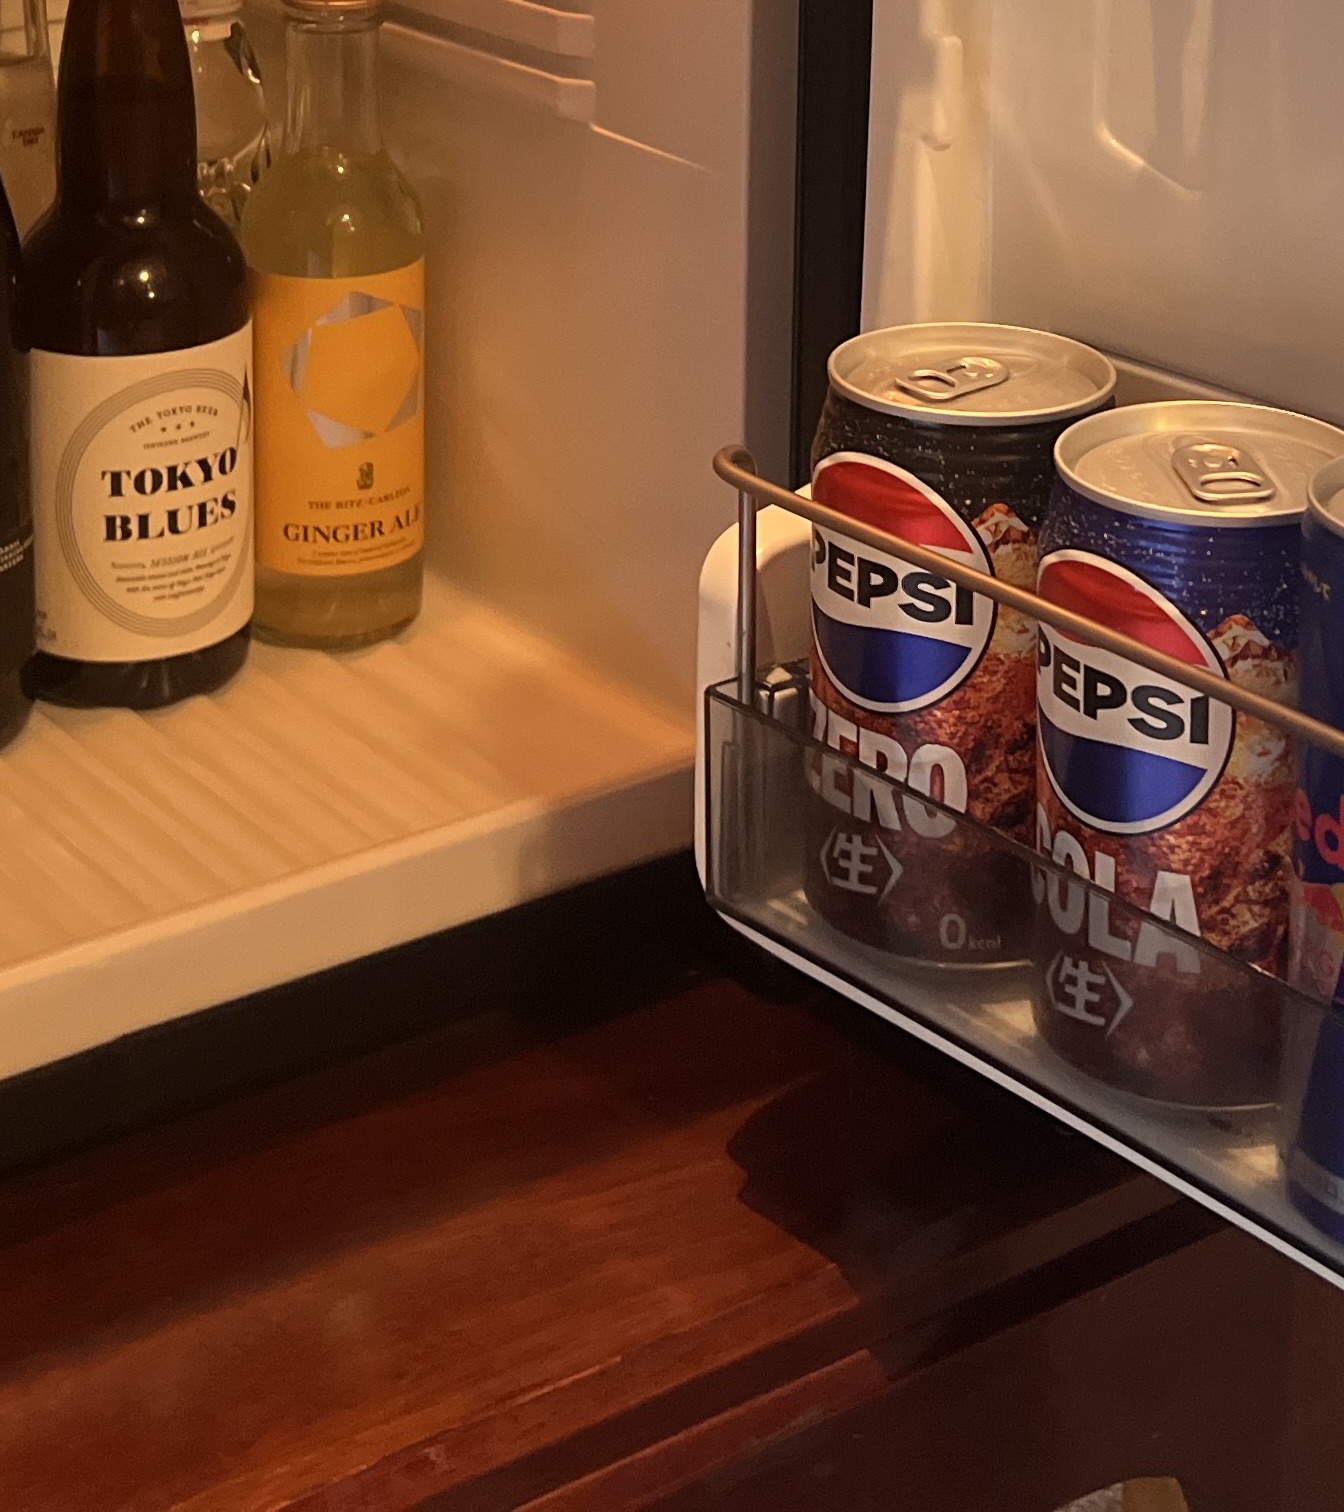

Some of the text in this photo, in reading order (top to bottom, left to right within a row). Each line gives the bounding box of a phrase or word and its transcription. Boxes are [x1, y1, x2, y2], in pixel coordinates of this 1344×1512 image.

[101, 446, 238, 498] TOKYO
[102, 490, 238, 543] BLUES
[282, 519, 386, 545] GINGER
[812, 526, 974, 626] PEPSI
[1037, 623, 1211, 746] PEPSI
